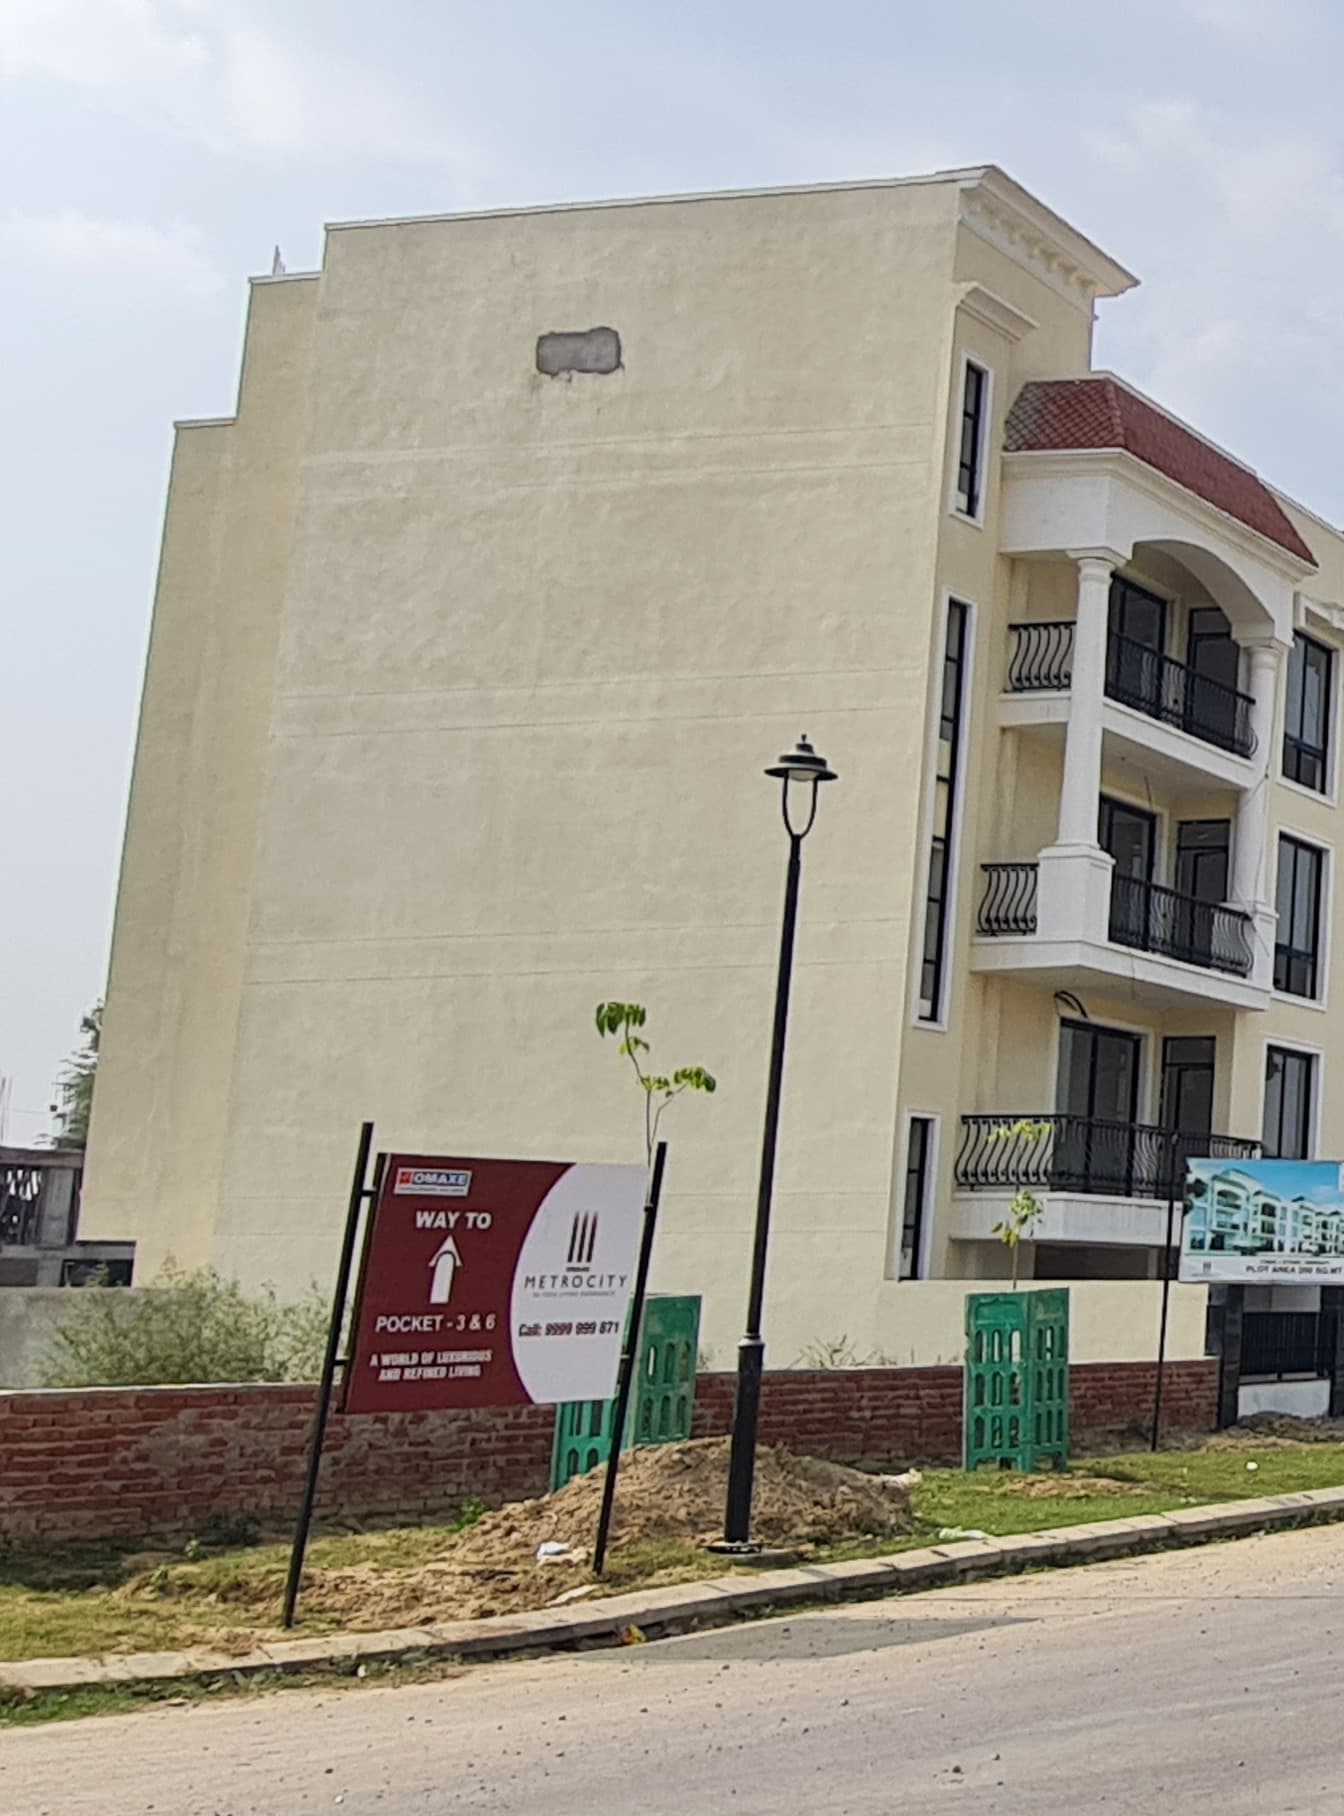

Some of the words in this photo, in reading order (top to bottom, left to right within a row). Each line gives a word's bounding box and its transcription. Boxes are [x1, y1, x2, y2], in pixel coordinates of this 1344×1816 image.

[414, 1172, 467, 1185] OMAXE
[416, 1211, 460, 1228] WAY
[464, 1212, 492, 1229] TO
[524, 1275, 627, 1289] METROCITY
[375, 1315, 444, 1332] POCKET
[456, 1314, 466, 1331] 3
[469, 1314, 481, 1330] &
[486, 1314, 496, 1330] 6
[369, 1353, 379, 1367] A
[380, 1352, 419, 1366] WORLD
[420, 1351, 435, 1365] OF
[437, 1349, 493, 1364] LUXURIOUS
[378, 1367, 401, 1381] AND
[402, 1366, 447, 1381] REFINED
[448, 1364, 481, 1378] LIVING
